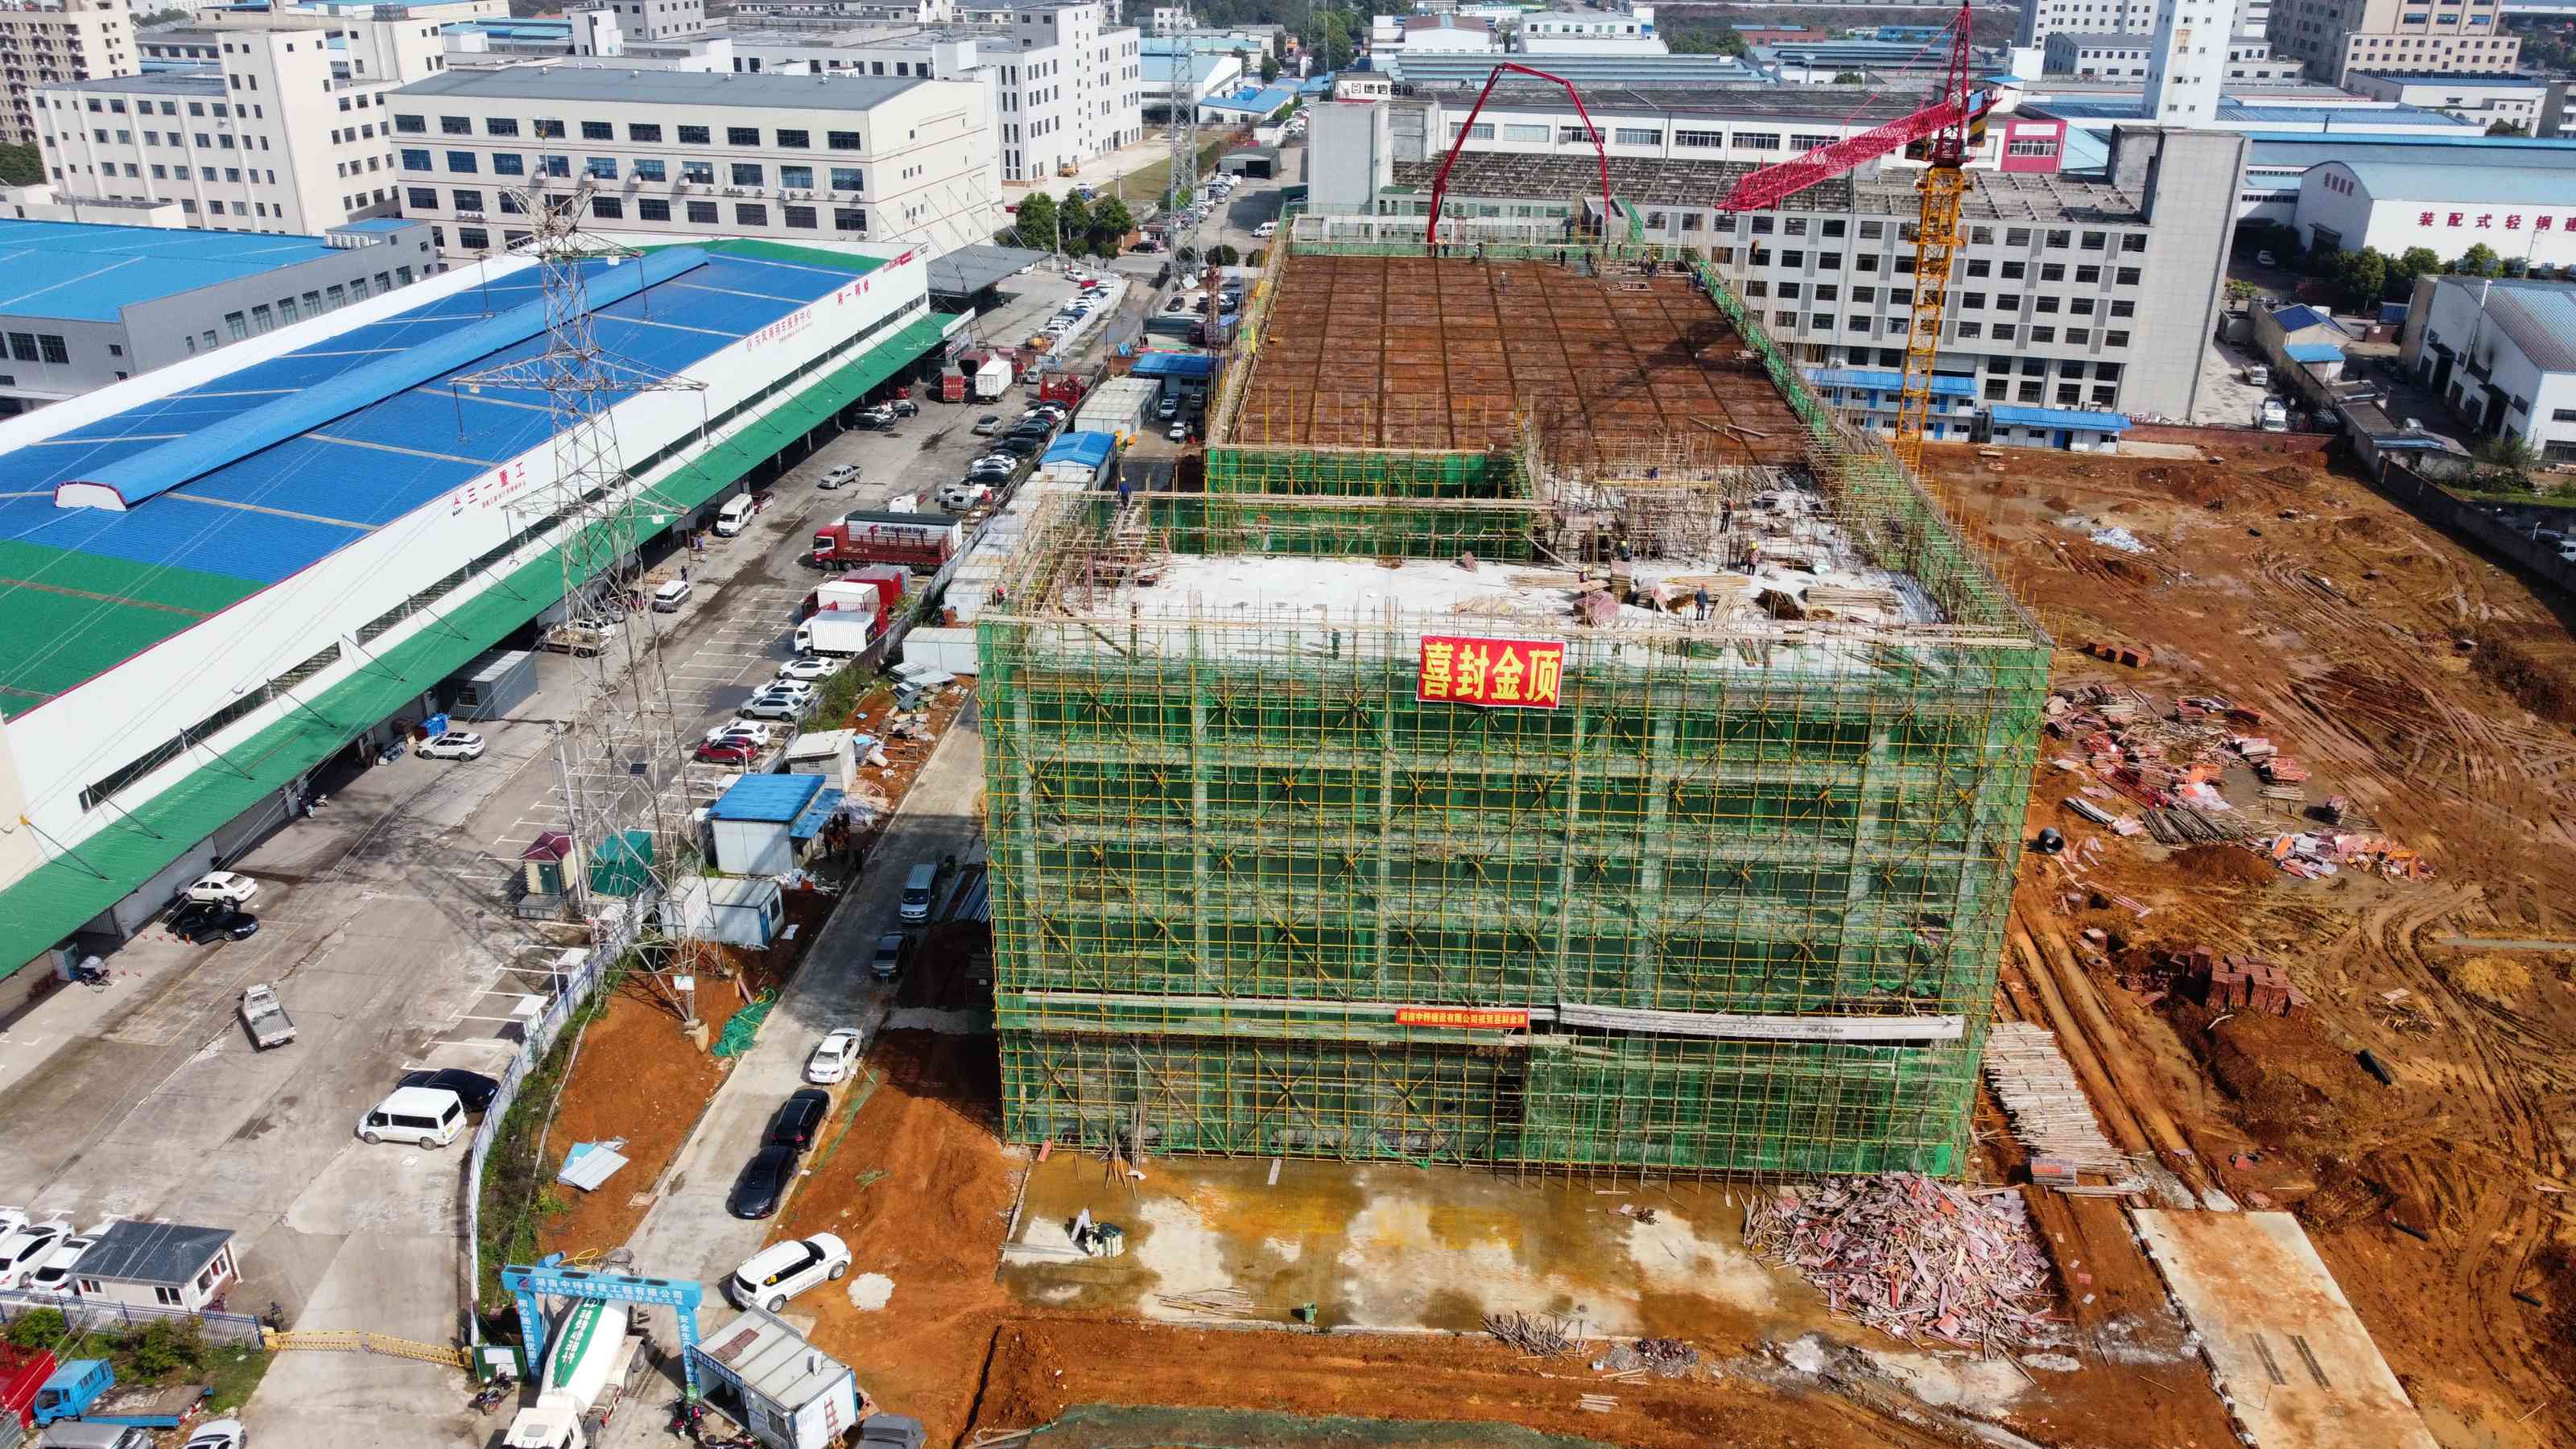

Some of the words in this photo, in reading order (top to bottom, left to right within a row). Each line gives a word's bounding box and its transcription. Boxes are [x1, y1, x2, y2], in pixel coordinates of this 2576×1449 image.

[2418, 211, 2576, 233] 装配式轻钢建
[466, 461, 526, 505] 三一重工
[1422, 641, 1561, 704] 喜封金顶
